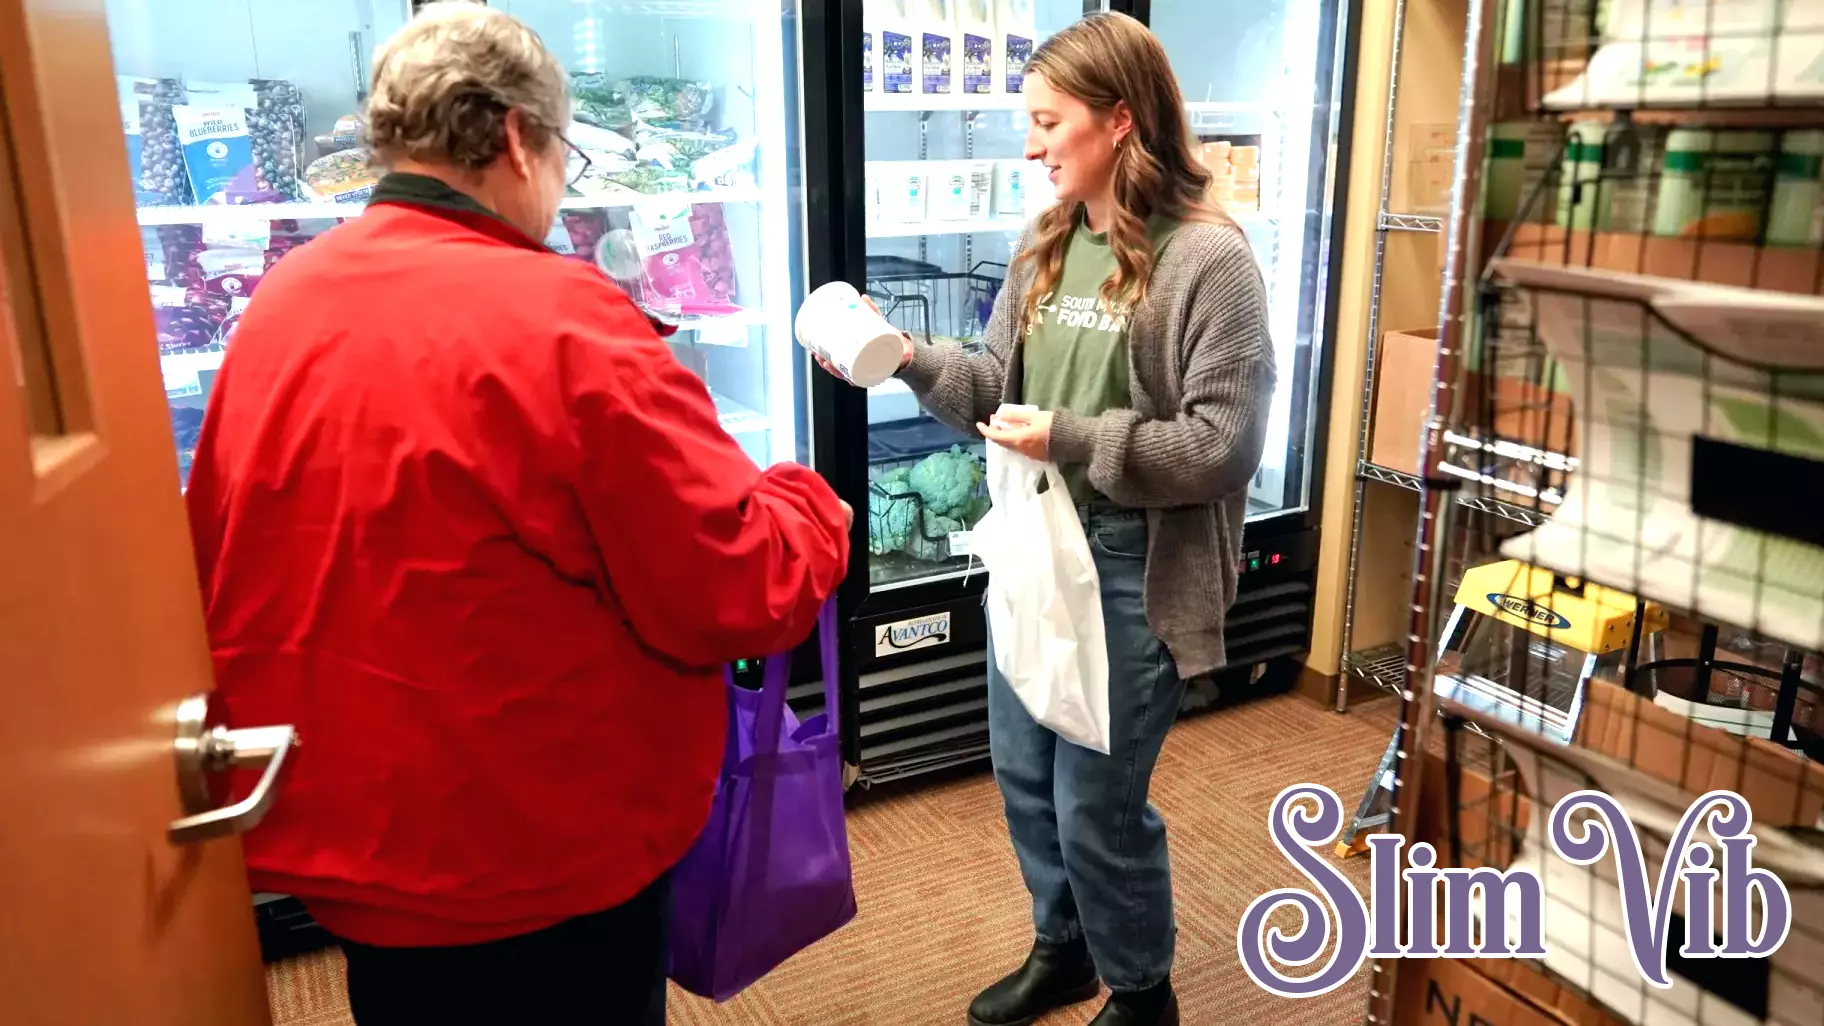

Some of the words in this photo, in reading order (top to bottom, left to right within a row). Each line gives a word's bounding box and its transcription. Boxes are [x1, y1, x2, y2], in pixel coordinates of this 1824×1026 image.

[189, 123, 240, 137] BLUEBERRIES
[658, 232, 672, 242] RED
[1061, 295, 1097, 310] SOUTH
[878, 619, 948, 649] AVANTCO
